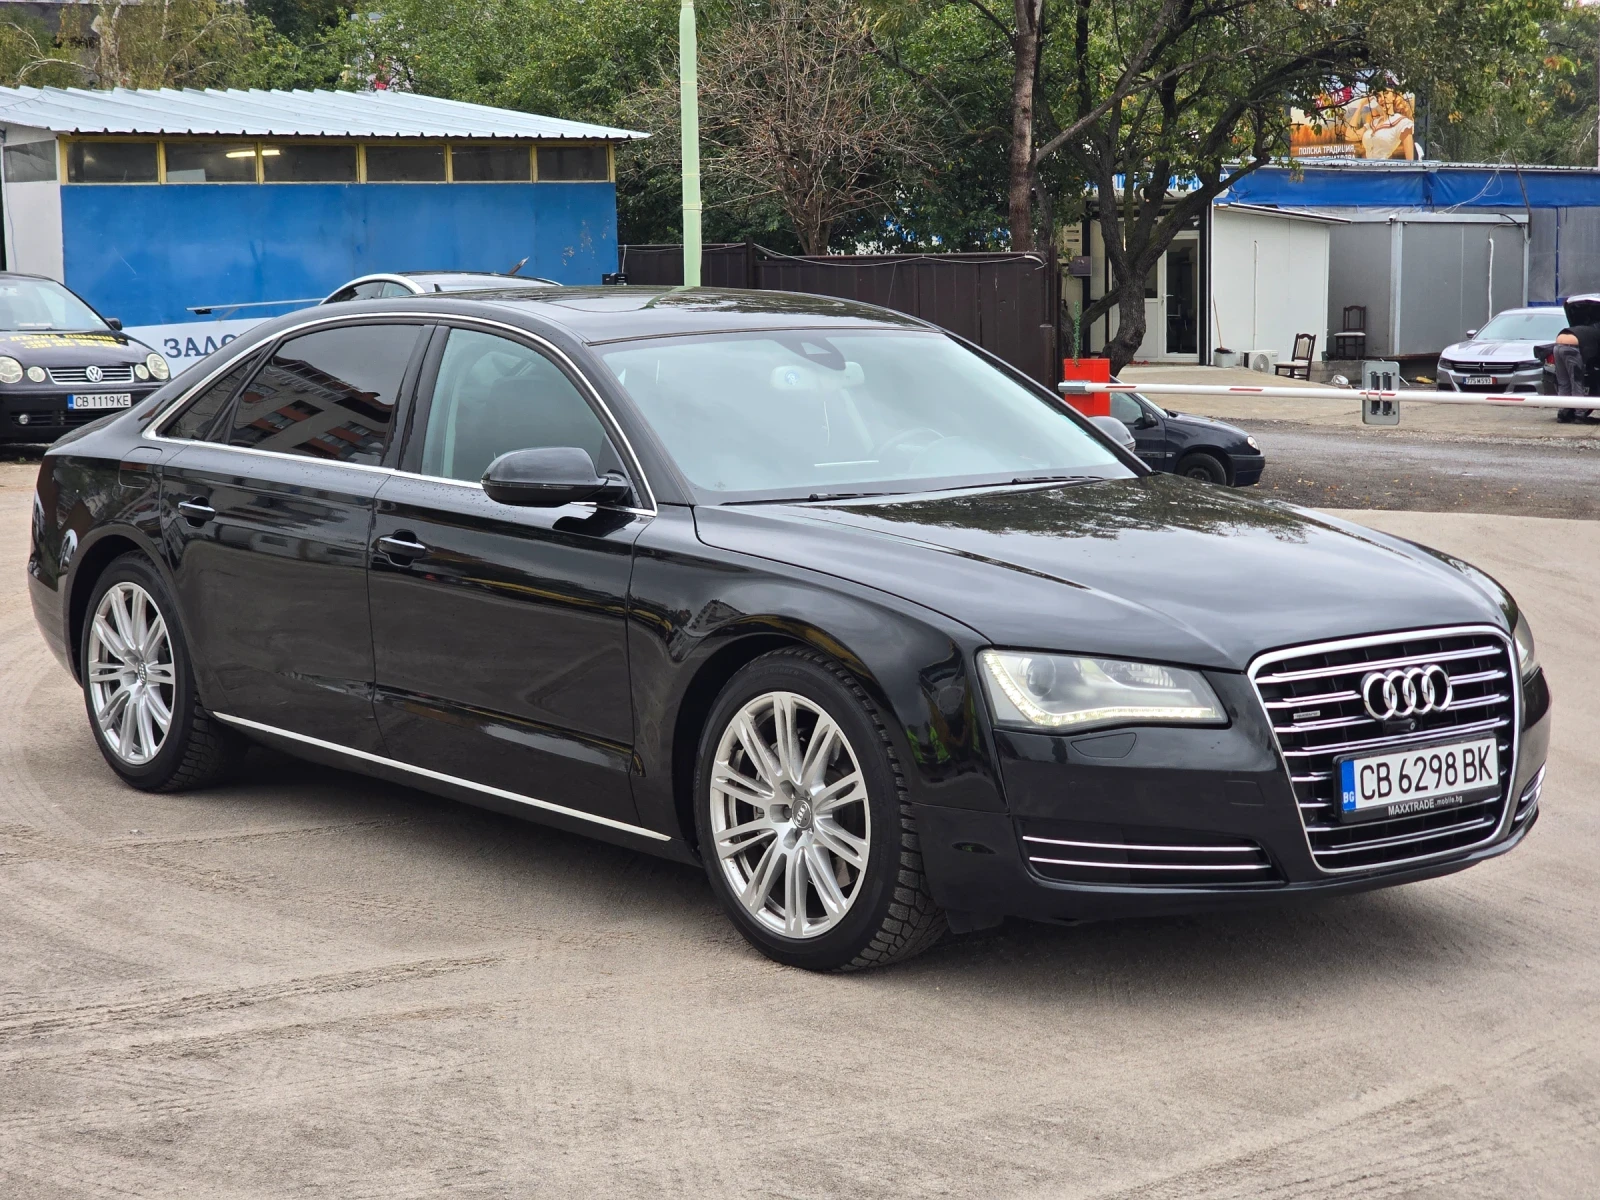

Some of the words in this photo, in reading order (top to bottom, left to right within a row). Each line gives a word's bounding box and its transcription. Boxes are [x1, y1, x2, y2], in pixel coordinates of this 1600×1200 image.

[1298, 147, 1322, 156] ПОЛСКА
[75, 396, 89, 408] CB
[91, 396, 115, 408] 1119
[116, 395, 129, 407] KE
[1360, 762, 1392, 800] CB
[1398, 751, 1458, 794] 6298
[1463, 744, 1493, 784] BK
[1343, 791, 1355, 803] BG
